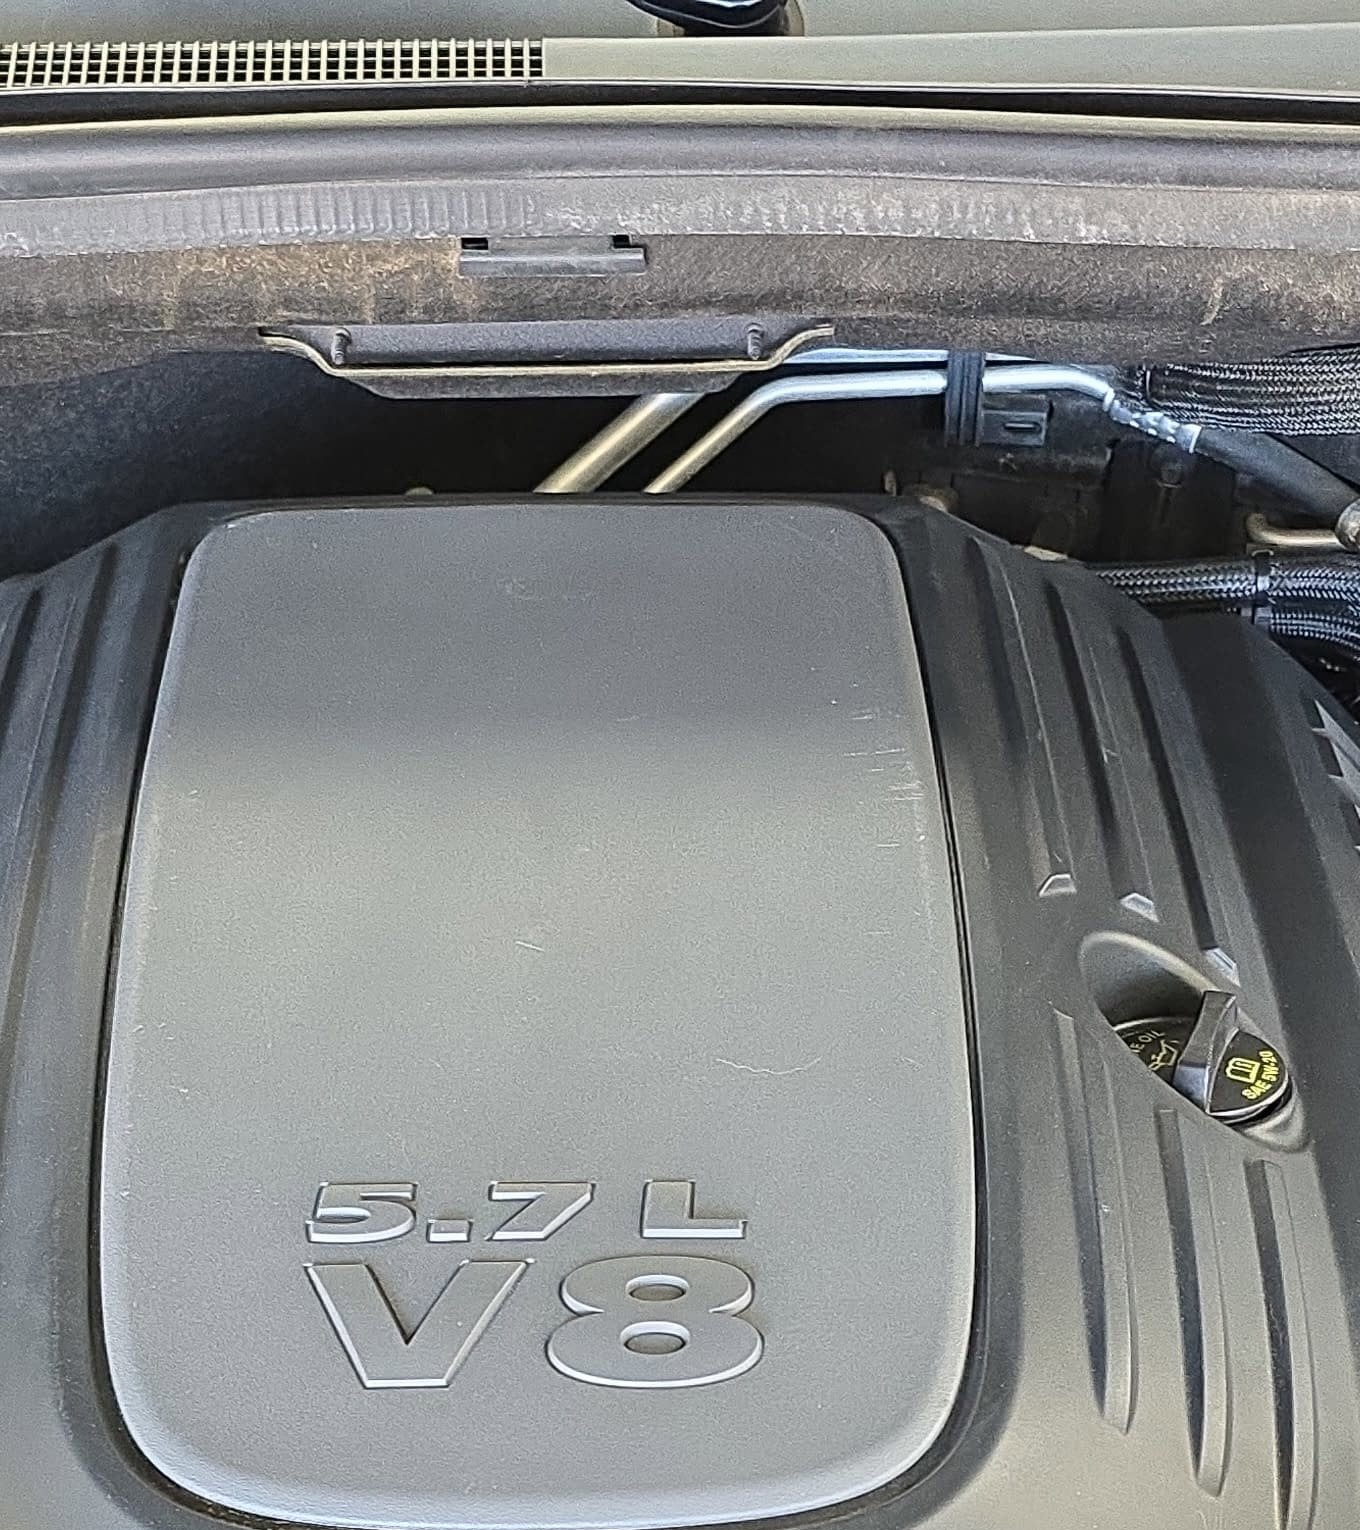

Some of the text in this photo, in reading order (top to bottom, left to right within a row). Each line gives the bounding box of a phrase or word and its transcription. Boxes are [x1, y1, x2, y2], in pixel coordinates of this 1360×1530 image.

[1138, 1029, 1166, 1043] OIL
[1241, 1050, 1281, 1101] SAE 5W-20
[305, 1179, 748, 1244] 5.7 L
[301, 1255, 765, 1390] V8
